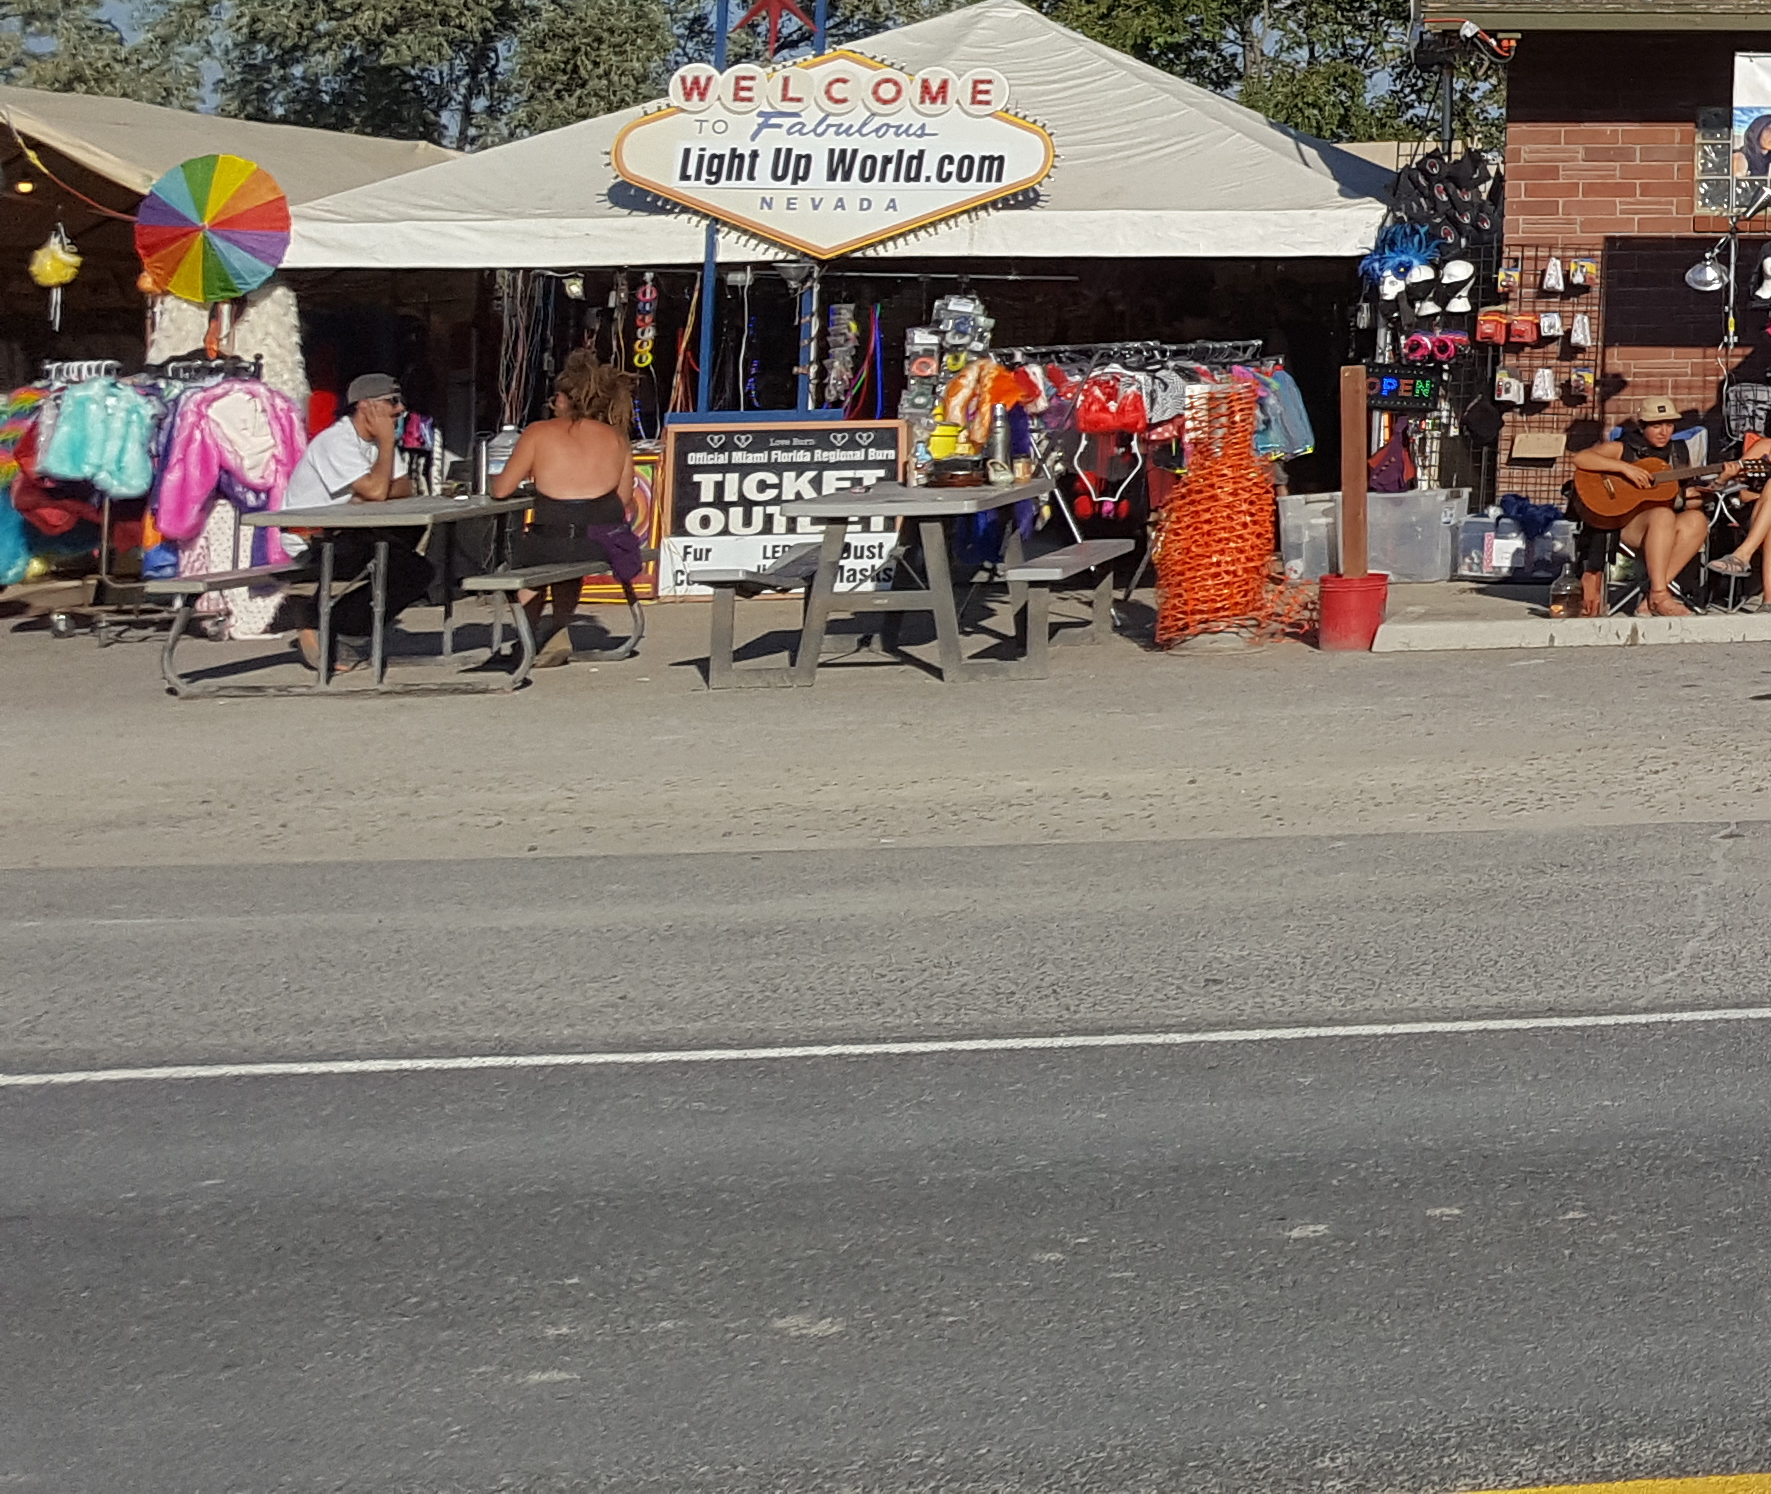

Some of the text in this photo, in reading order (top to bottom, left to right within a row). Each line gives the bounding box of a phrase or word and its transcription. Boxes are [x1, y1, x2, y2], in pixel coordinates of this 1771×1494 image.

[680, 74, 995, 106] WELCOME
[694, 111, 938, 142] TO Fabulous
[679, 147, 1006, 185] Light Up World.com
[759, 196, 899, 212] NEVADA
[1366, 376, 1431, 397] OPEN
[769, 437, 790, 447] Love
[687, 448, 895, 465] Official Miami Florida Regional Burn
[682, 545, 713, 562] Fur
